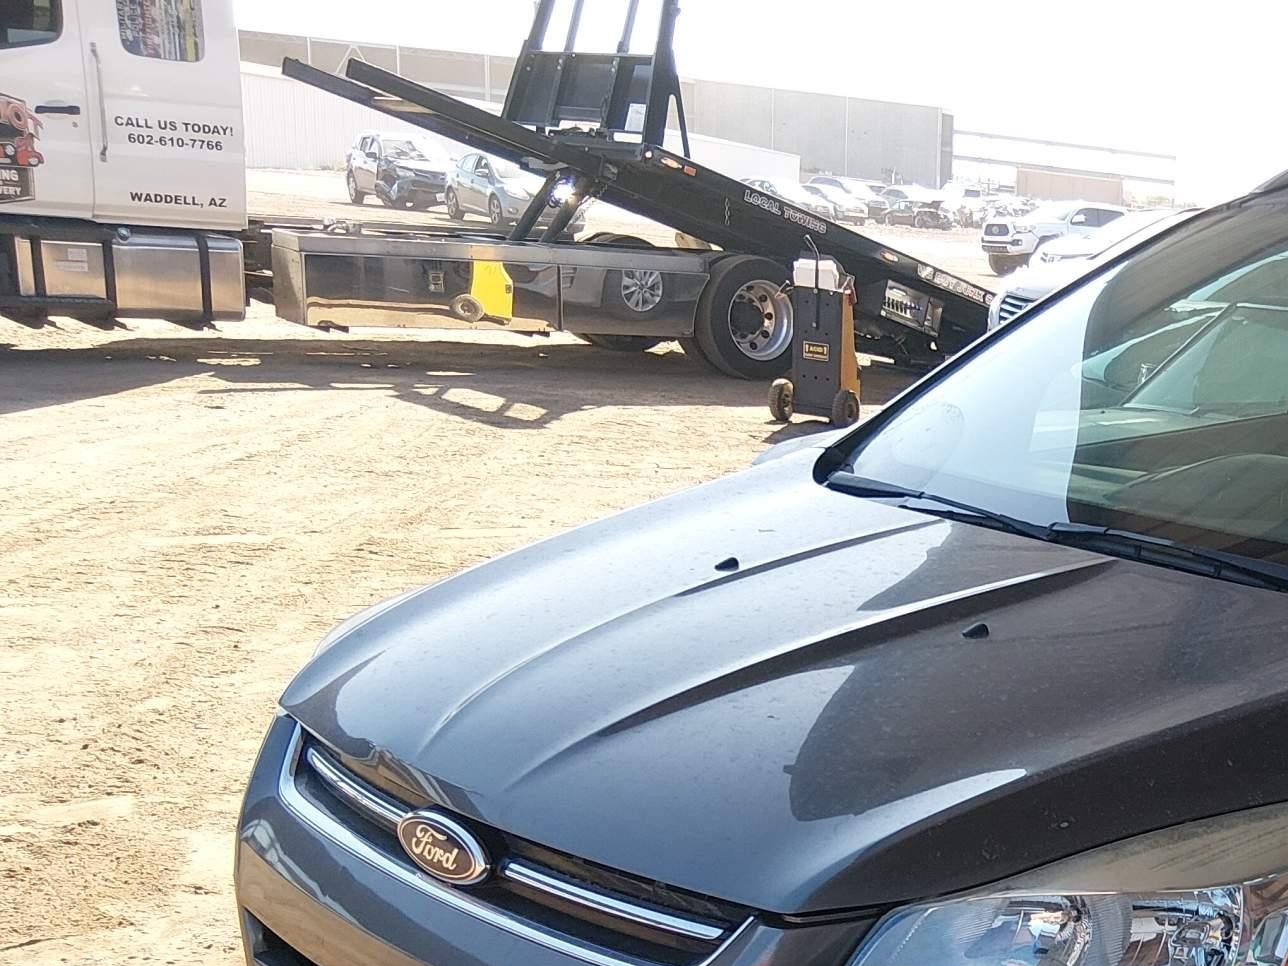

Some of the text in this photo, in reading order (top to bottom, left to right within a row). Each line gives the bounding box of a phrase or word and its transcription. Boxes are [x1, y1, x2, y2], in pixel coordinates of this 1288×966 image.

[114, 115, 233, 136] CALL US TODAY!
[127, 133, 223, 151] 602-610-7766
[129, 191, 227, 208] WADDELL, AZ
[743, 189, 827, 233] LOCAL TOWING
[411, 824, 459, 870] Ford
